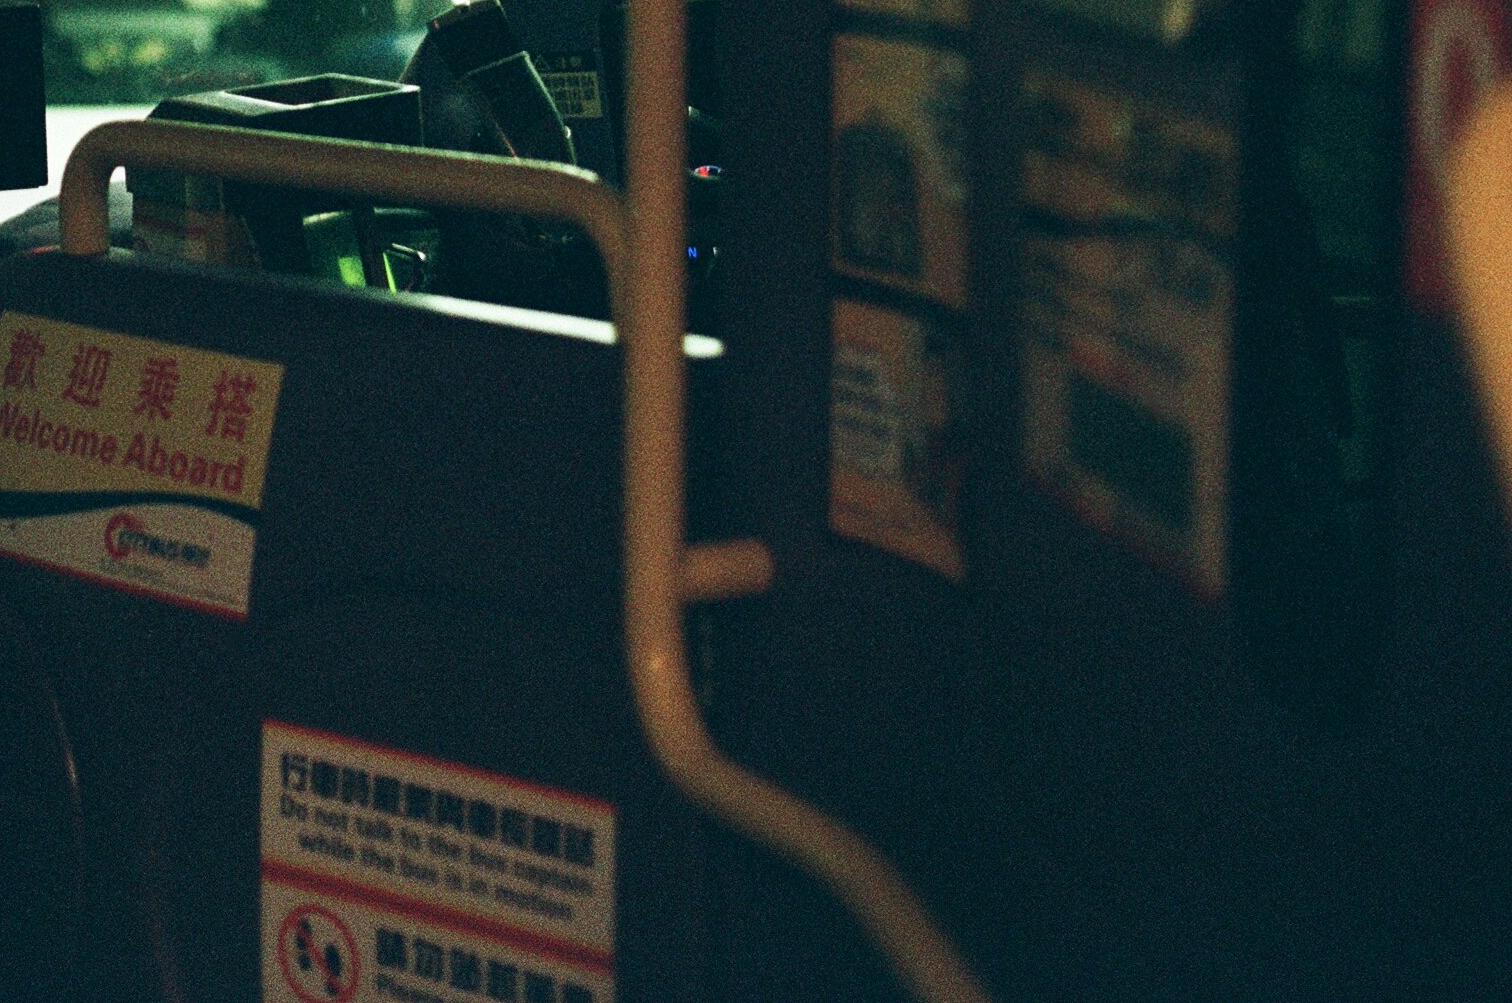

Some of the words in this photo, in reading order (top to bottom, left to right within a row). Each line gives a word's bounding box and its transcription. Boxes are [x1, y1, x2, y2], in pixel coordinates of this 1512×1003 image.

[2, 329, 258, 443] 歡迎乘搭
[122, 432, 247, 496] Aboard
